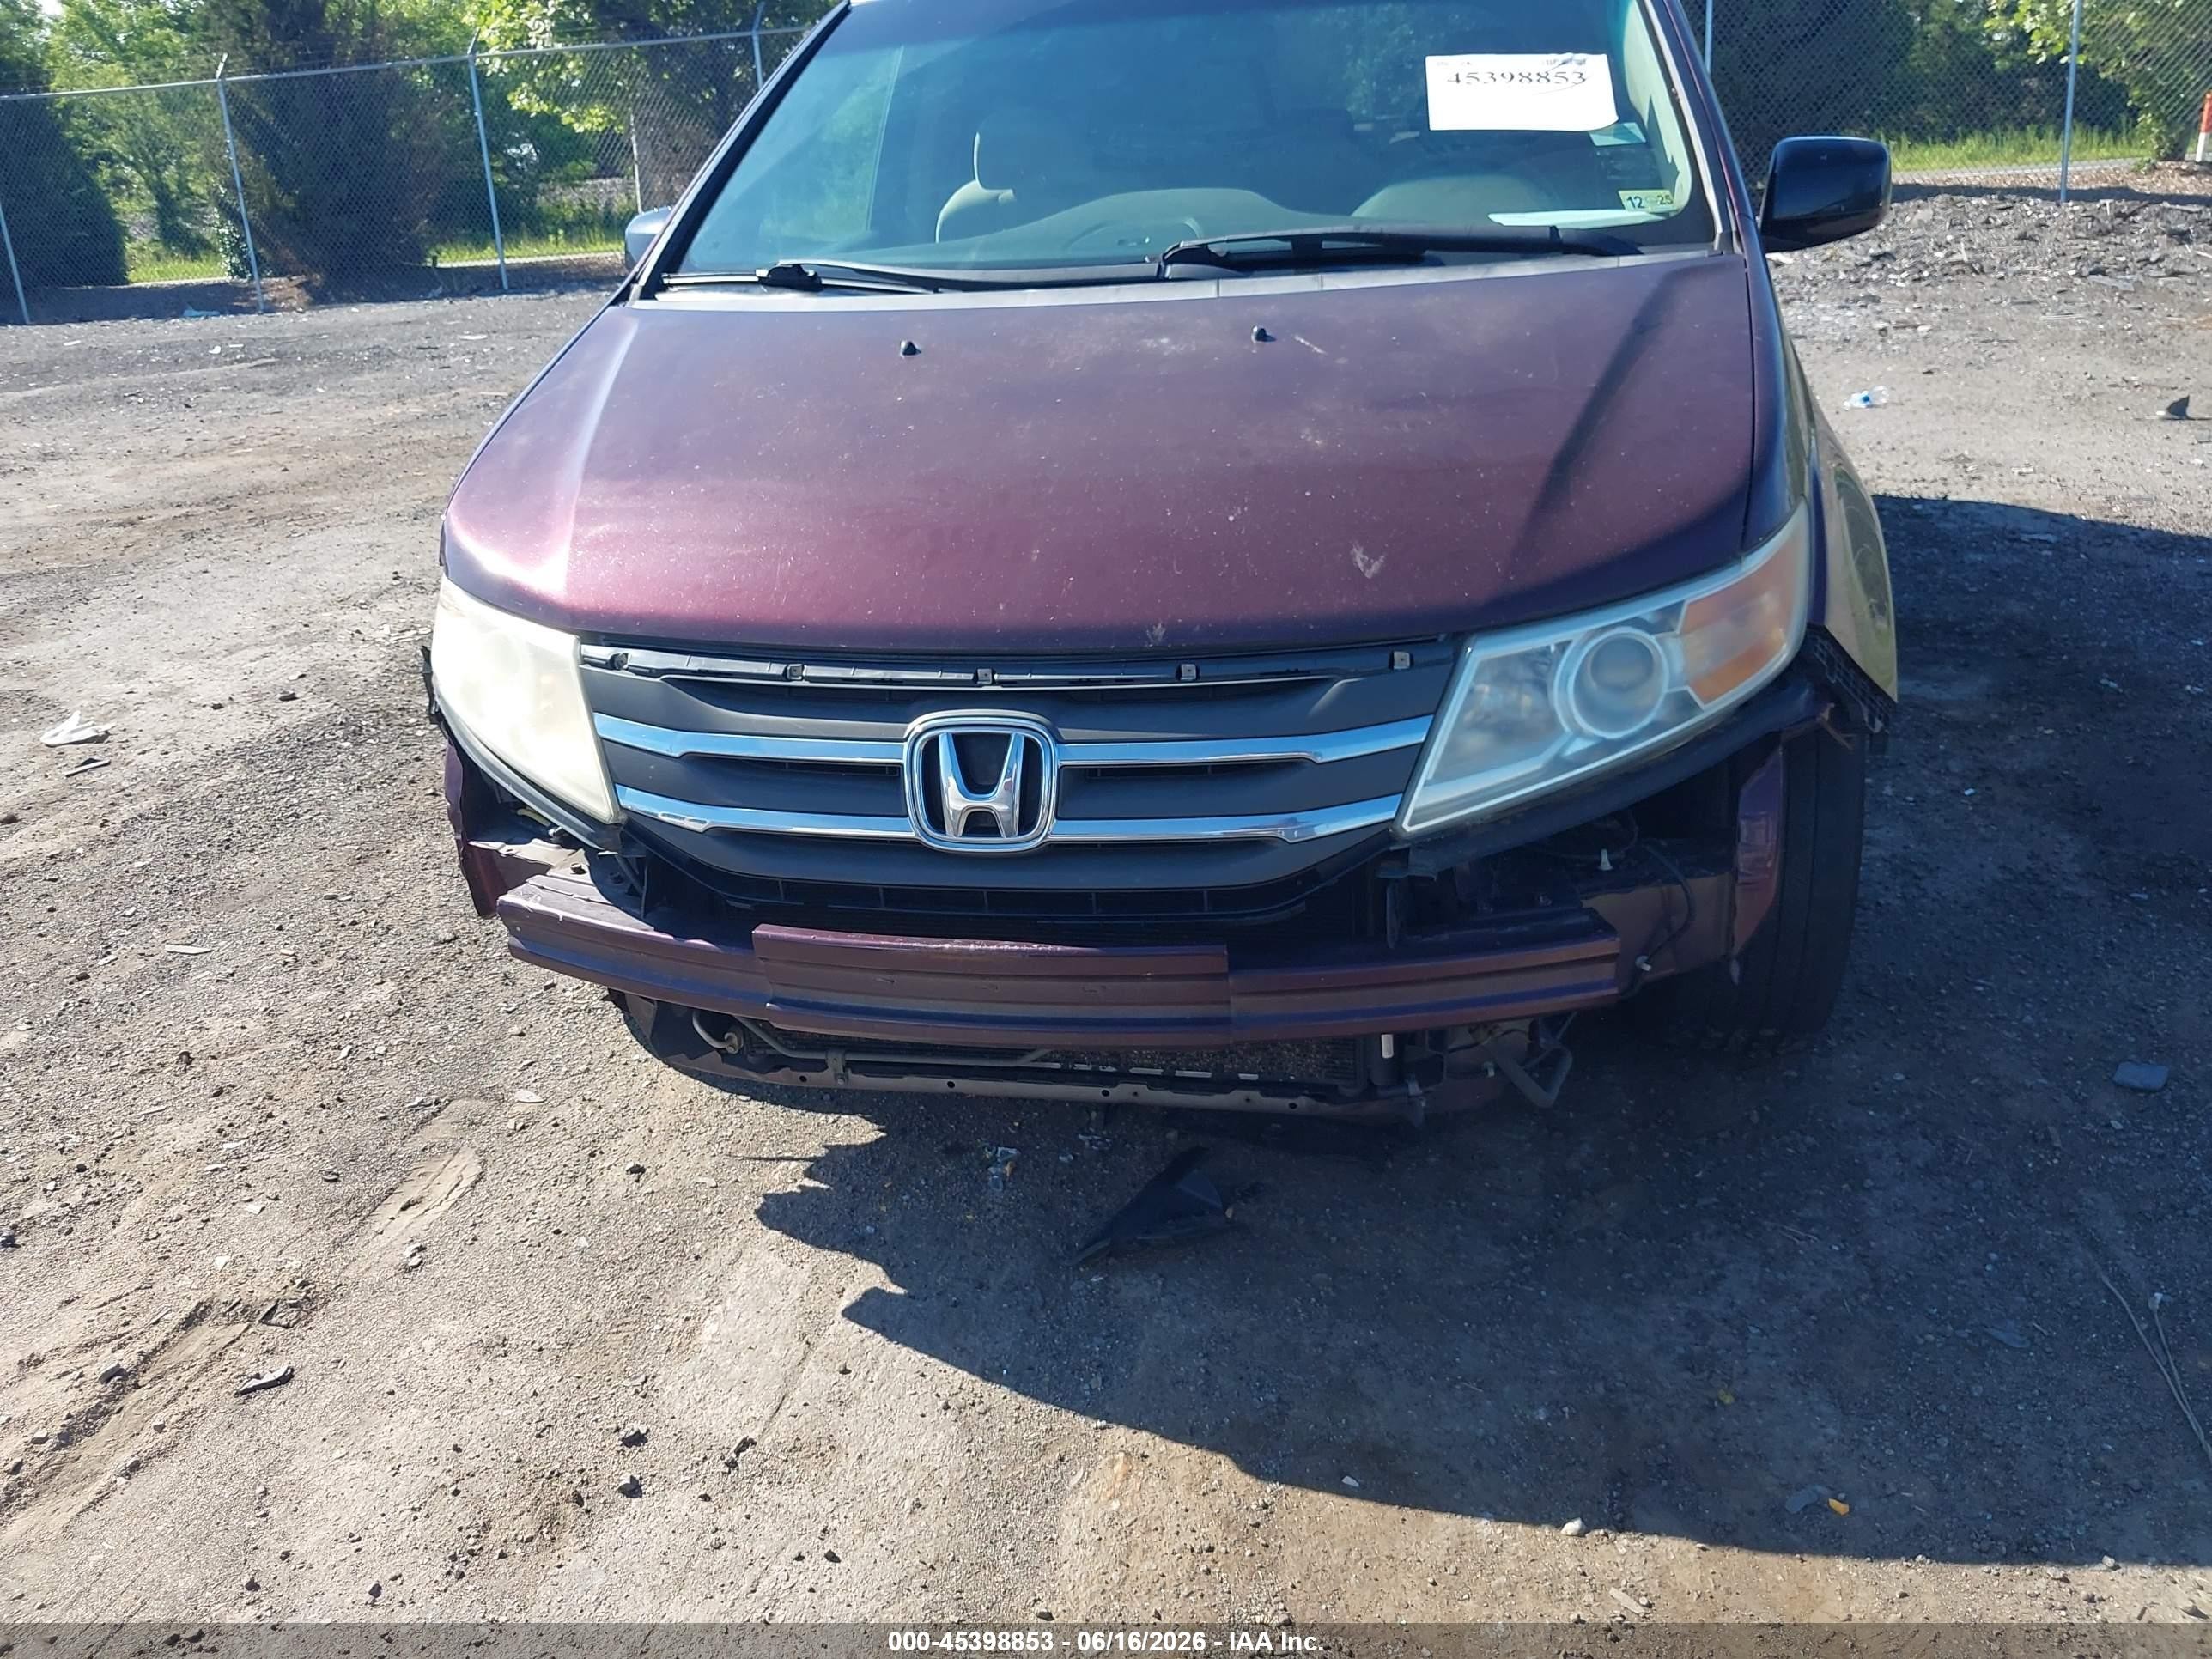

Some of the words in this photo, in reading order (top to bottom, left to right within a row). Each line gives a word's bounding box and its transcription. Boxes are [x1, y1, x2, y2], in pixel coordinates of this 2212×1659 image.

[1447, 71, 1587, 85] 45398853
[1626, 196, 1645, 209] 12
[1657, 194, 1674, 205] 25
